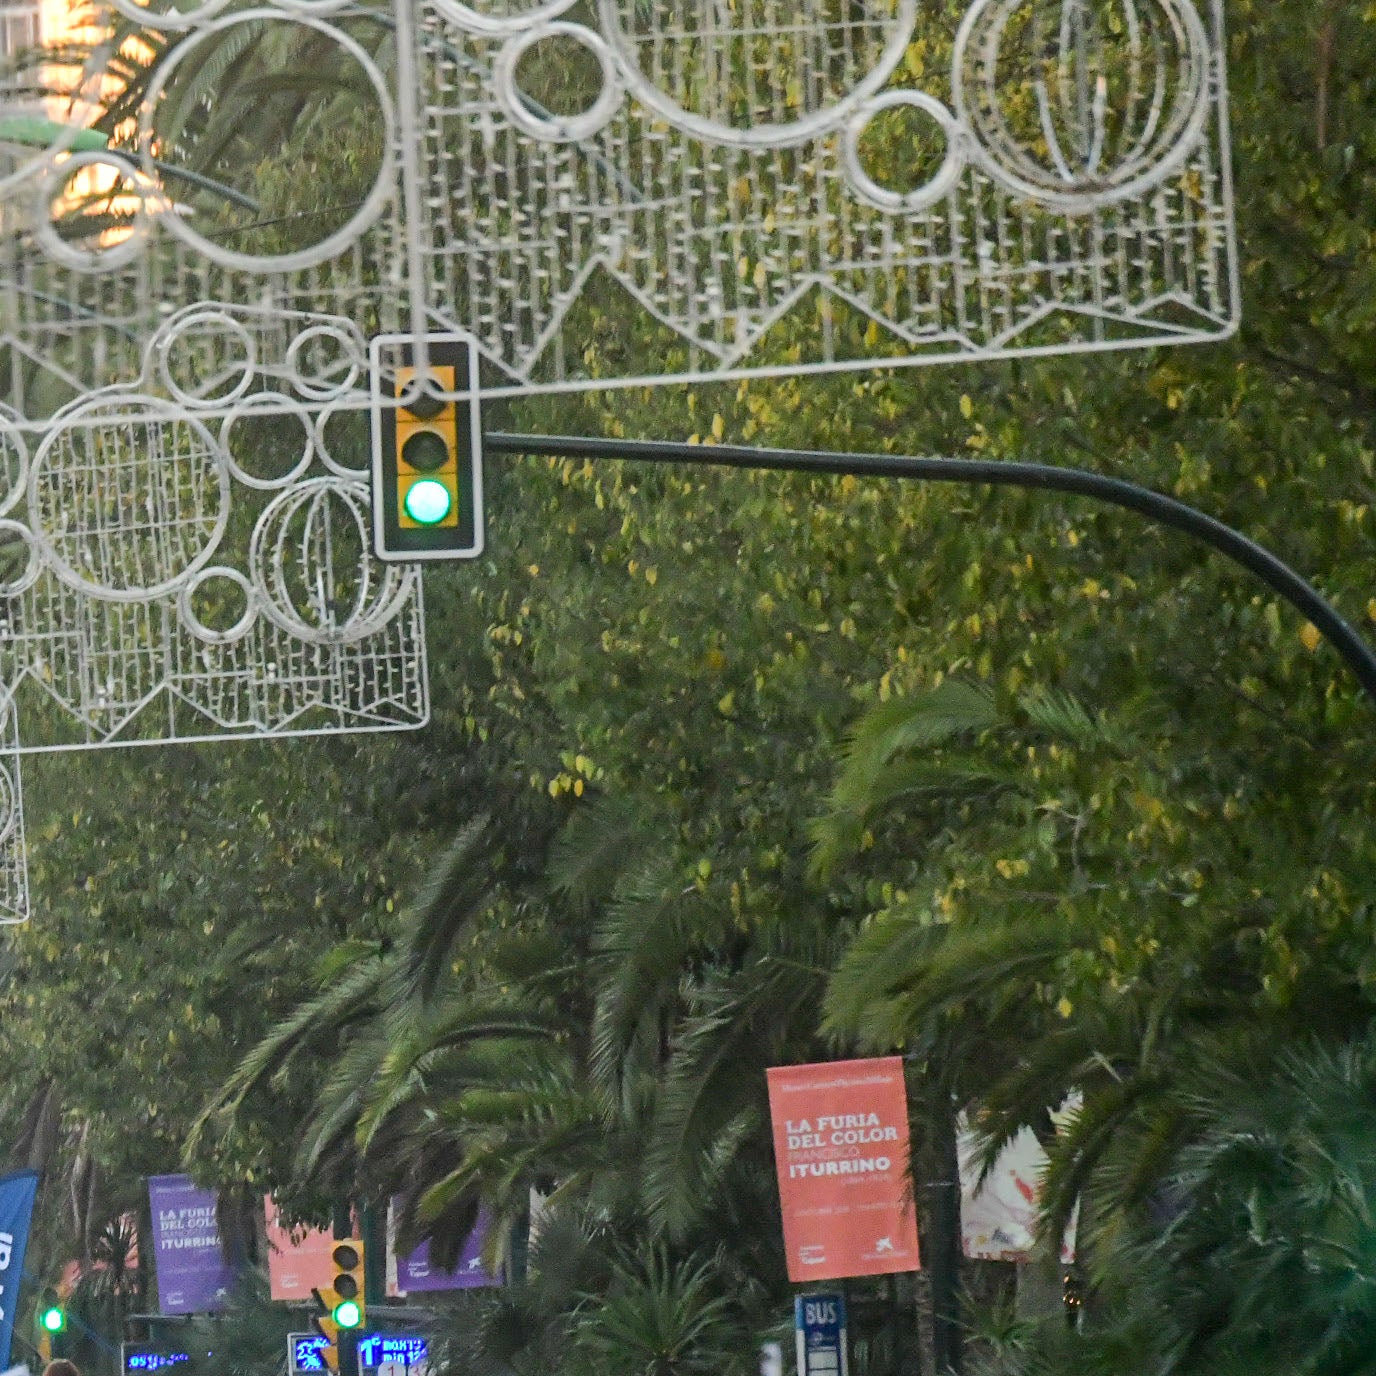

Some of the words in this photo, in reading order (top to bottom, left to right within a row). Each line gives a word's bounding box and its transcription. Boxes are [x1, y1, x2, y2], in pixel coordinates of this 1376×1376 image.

[786, 1119, 812, 1135] LA
[818, 1112, 880, 1132] FURIA
[787, 1133, 827, 1150] DEL
[831, 1126, 898, 1146] COLOR
[789, 1156, 892, 1179] ITURRINO
[806, 1302, 836, 1325] BUS
